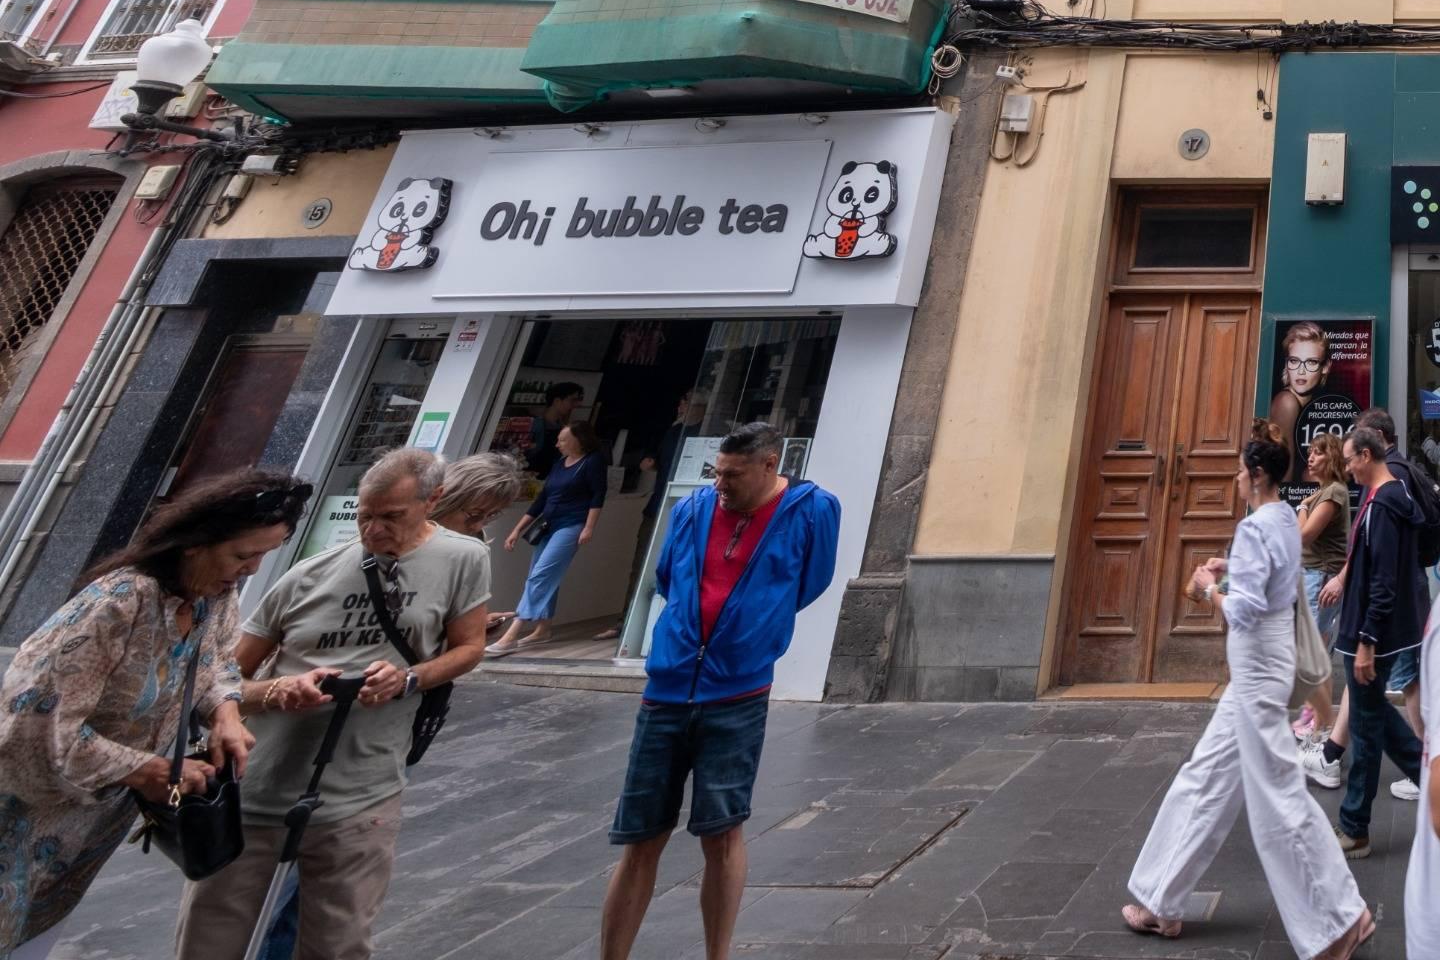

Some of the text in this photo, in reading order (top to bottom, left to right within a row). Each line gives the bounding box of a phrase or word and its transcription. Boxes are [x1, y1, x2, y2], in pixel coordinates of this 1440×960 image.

[1185, 136, 1203, 152] 17
[308, 206, 324, 221] 15
[565, 194, 704, 238] bubble
[718, 198, 788, 235] tea
[1323, 331, 1369, 340] Miradas que
[1360, 341, 1368, 349] la
[1331, 352, 1368, 360] diferencia
[1309, 411, 1358, 419] PROGRESIVAS
[329, 512, 358, 521] BUBB
[342, 593, 370, 610] OH
[341, 612, 353, 628] I
[316, 631, 353, 650] MY
